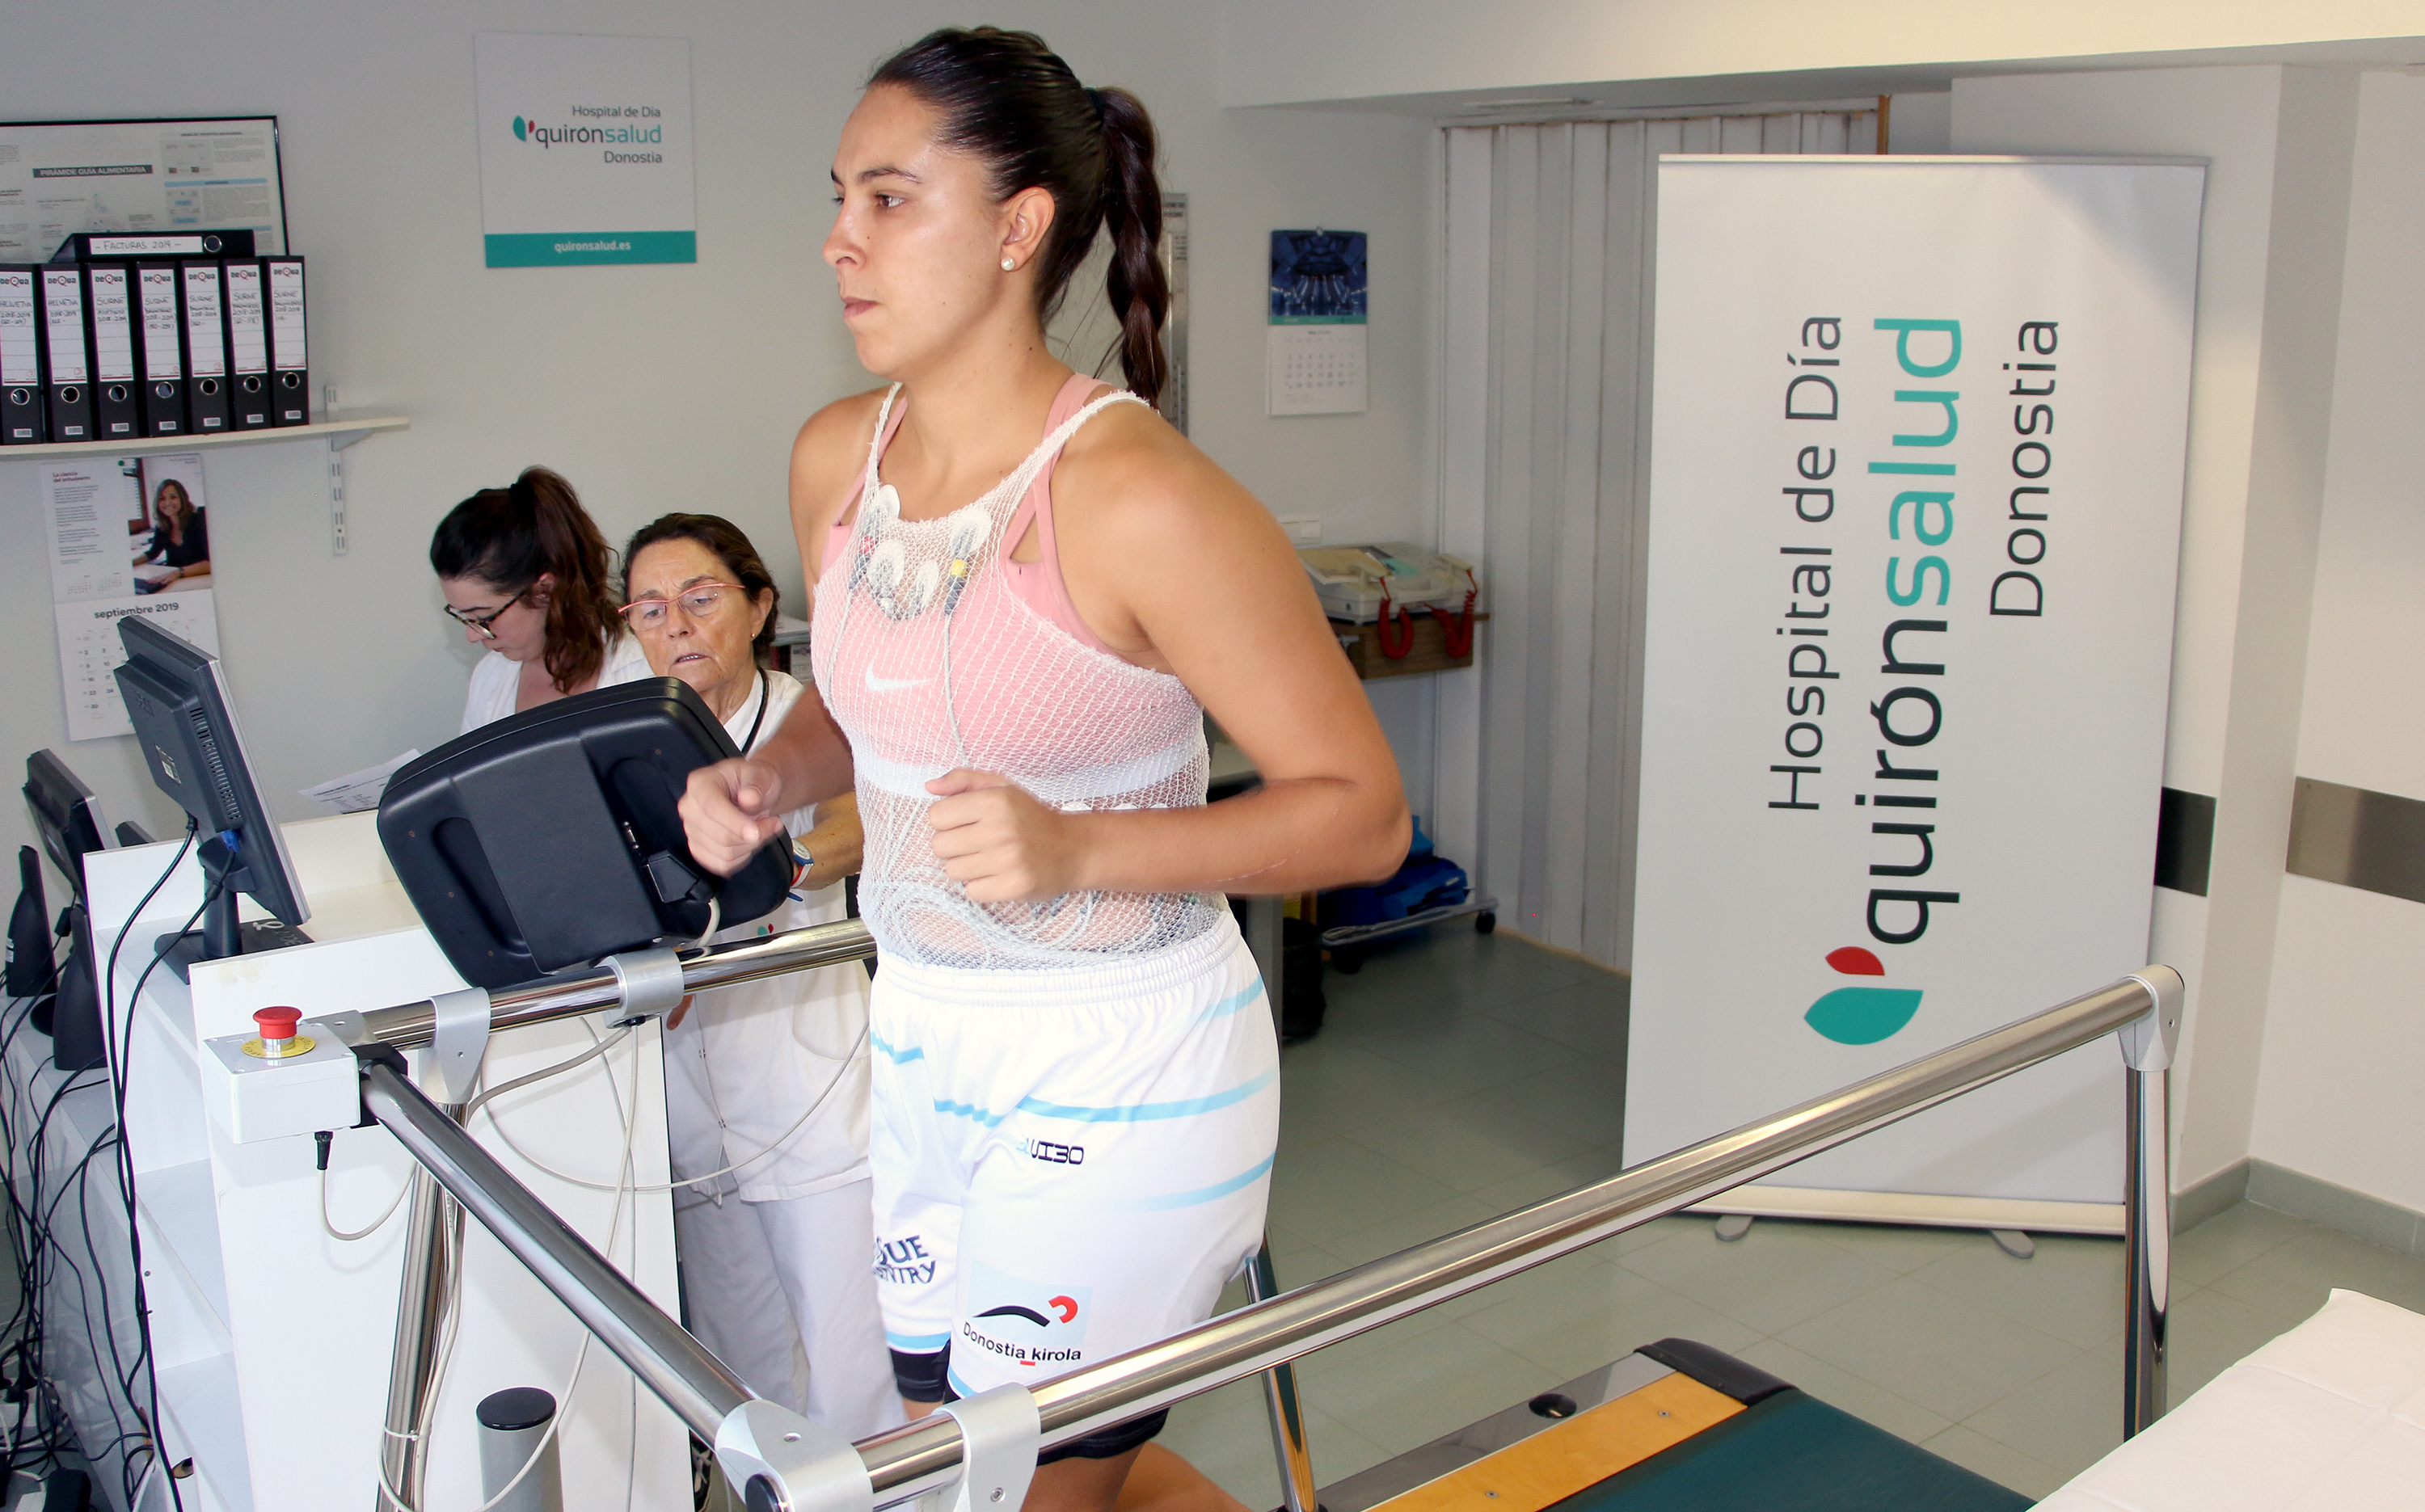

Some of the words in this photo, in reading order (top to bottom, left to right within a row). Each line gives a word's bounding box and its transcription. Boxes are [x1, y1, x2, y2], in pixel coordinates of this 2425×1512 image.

[571, 105, 621, 118] Hospital
[624, 106, 639, 117] de
[535, 124, 662, 150] quirónsalud
[604, 150, 663, 163] Donostia
[98, 166, 146, 175] ALIMENTARIA
[103, 240, 147, 250] FACTURAS
[152, 240, 171, 249] 2019
[555, 240, 631, 253] quironsalud.es
[1784, 316, 1842, 422] Día
[1989, 320, 2060, 618] Donostia
[1781, 444, 1837, 524] de
[95, 606, 154, 620] septiembre
[155, 602, 179, 613] 2019
[1854, 318, 1963, 946] quirónsalud
[1768, 545, 1841, 811] Hospital
[963, 1320, 1026, 1360] Donostia
[1031, 1347, 1082, 1362] kirola
